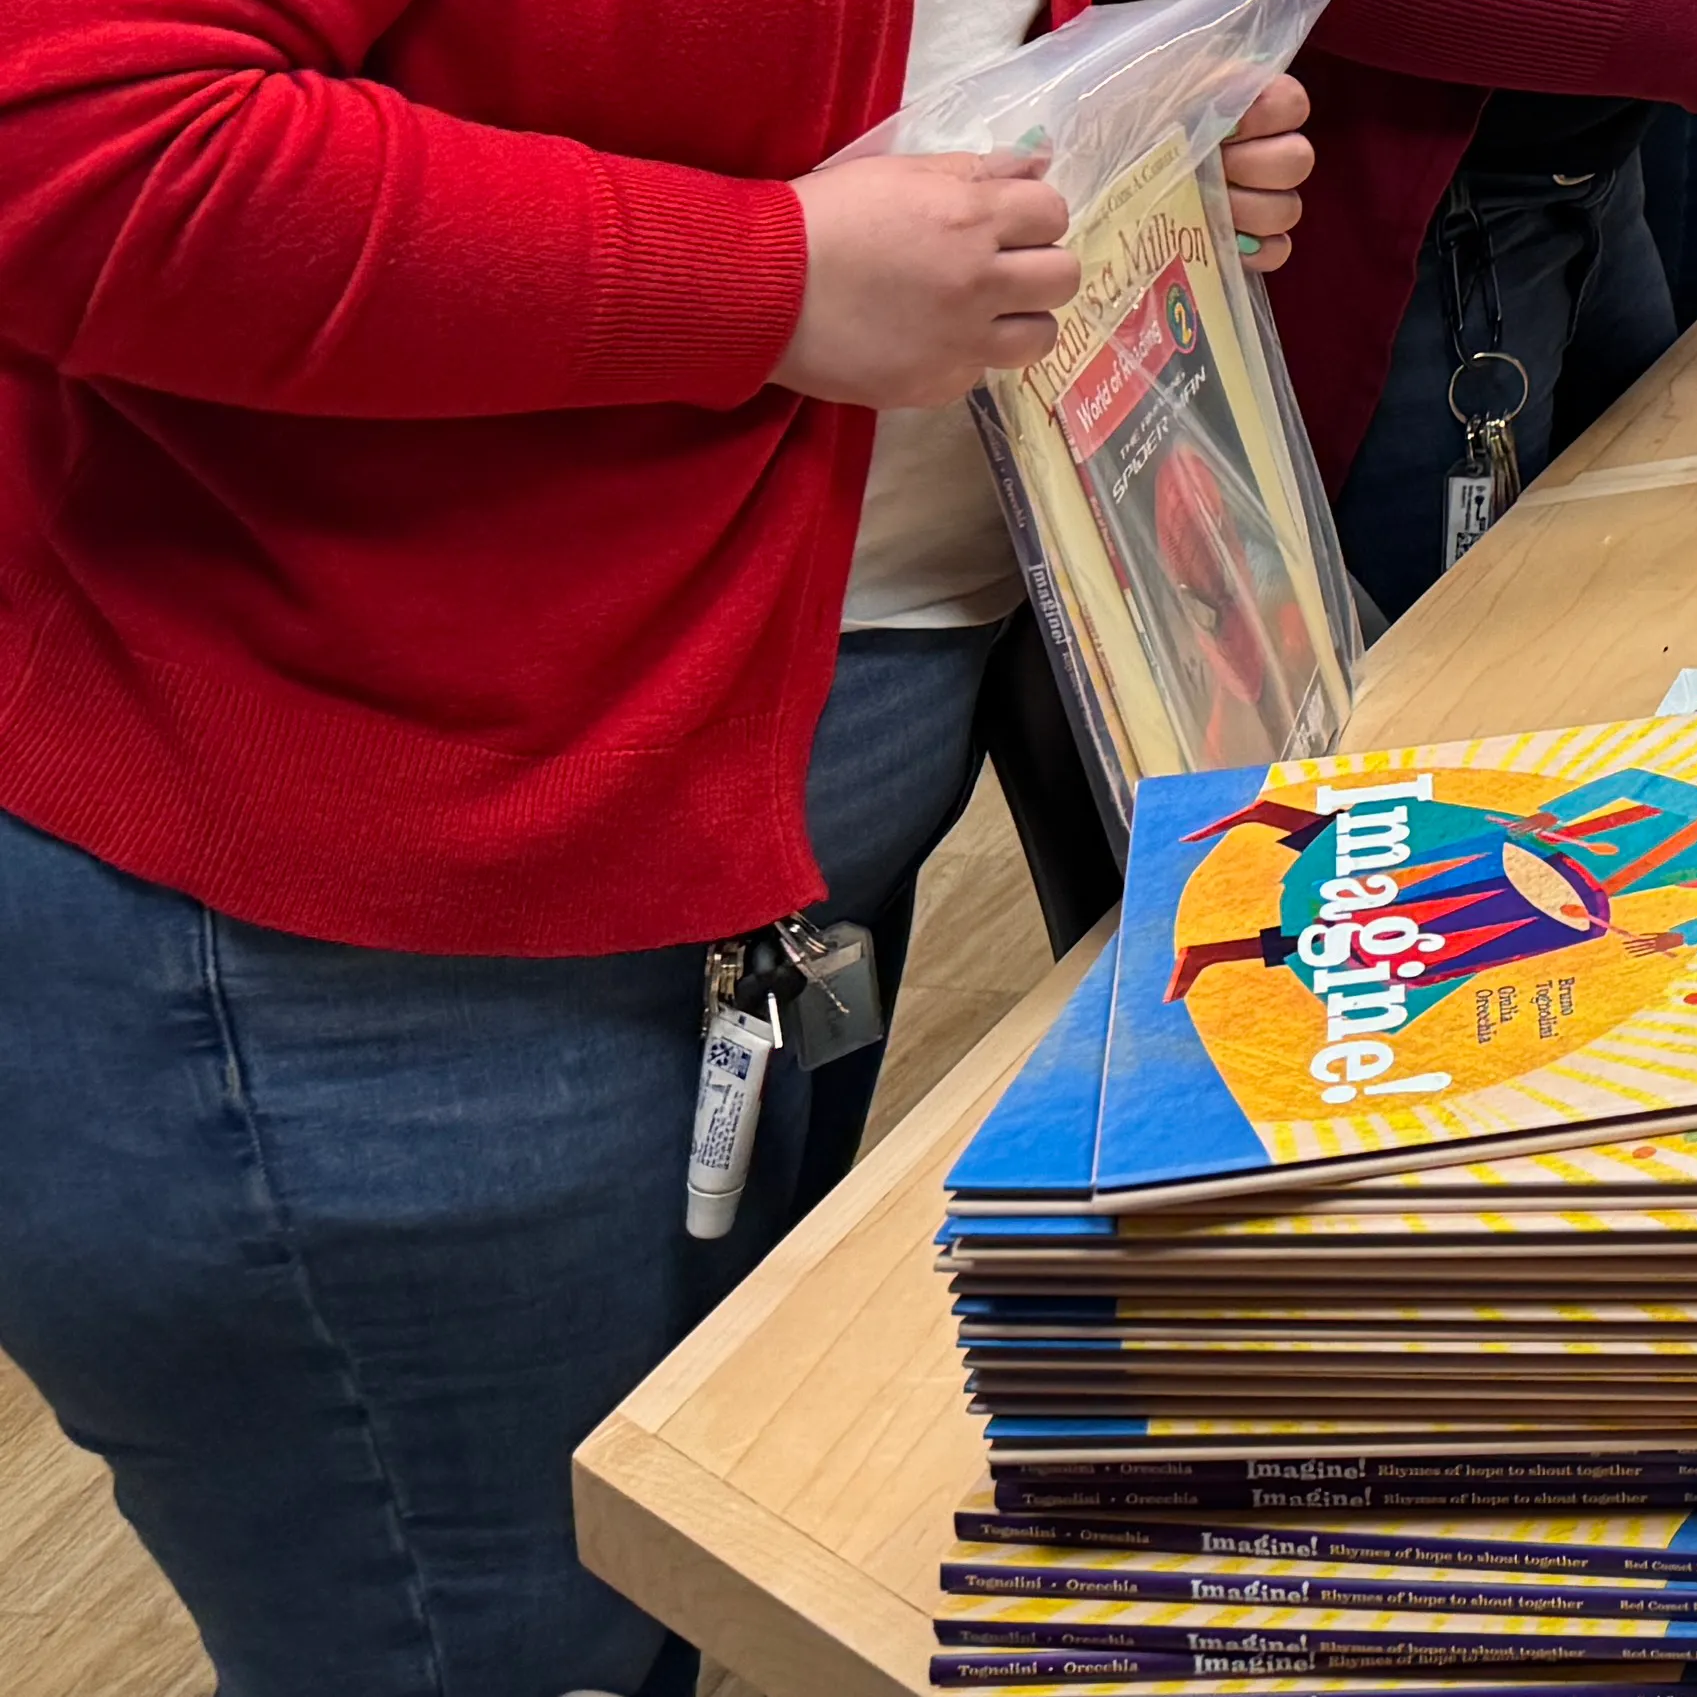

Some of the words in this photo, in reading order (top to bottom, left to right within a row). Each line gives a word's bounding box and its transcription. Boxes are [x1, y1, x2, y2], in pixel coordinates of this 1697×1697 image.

[1020, 280, 1105, 428] Thanks
[1101, 262, 1122, 302] a
[1118, 213, 1208, 288] Million
[1174, 302, 1192, 345] 2
[1076, 384, 1113, 435] World
[1108, 365, 1124, 392] of
[1297, 772, 1455, 1106] Imagine!
[1496, 986, 1514, 1026] Giulia
[1534, 980, 1556, 1043] Tognolini
[1557, 975, 1575, 1018] Bruno
[1474, 989, 1493, 1048] Orecchia
[1246, 1457, 1366, 1480] Imagine!
[1201, 1531, 1319, 1558] Imagine!
[1329, 1543, 1390, 1561] Rhymes
[1394, 1547, 1412, 1559] of
[1415, 1548, 1454, 1565] hope
[1457, 1552, 1472, 1563] to
[1479, 1552, 1521, 1565] shout
[1524, 1553, 1589, 1571] together
[1624, 1559, 1648, 1570] Red
[1652, 1561, 1692, 1572] Comet
[965, 1574, 1042, 1592] Tognolini
[1066, 1579, 1138, 1594] Orecchia
[1190, 1579, 1310, 1604] Imagine!
[1320, 1588, 1382, 1606] Rhymes
[1387, 1590, 1406, 1603] of
[1408, 1591, 1447, 1609] hope
[1451, 1595, 1467, 1606] to
[1471, 1594, 1514, 1609] shout
[1518, 1595, 1585, 1612] together
[1620, 1600, 1644, 1611] Red
[1648, 1601, 1689, 1612] Comet
[1187, 1633, 1309, 1655] Imagine!
[958, 1662, 1038, 1679] Tognolini
[1064, 1659, 1138, 1675] Orecchia
[1193, 1654, 1316, 1675] Imagine!
